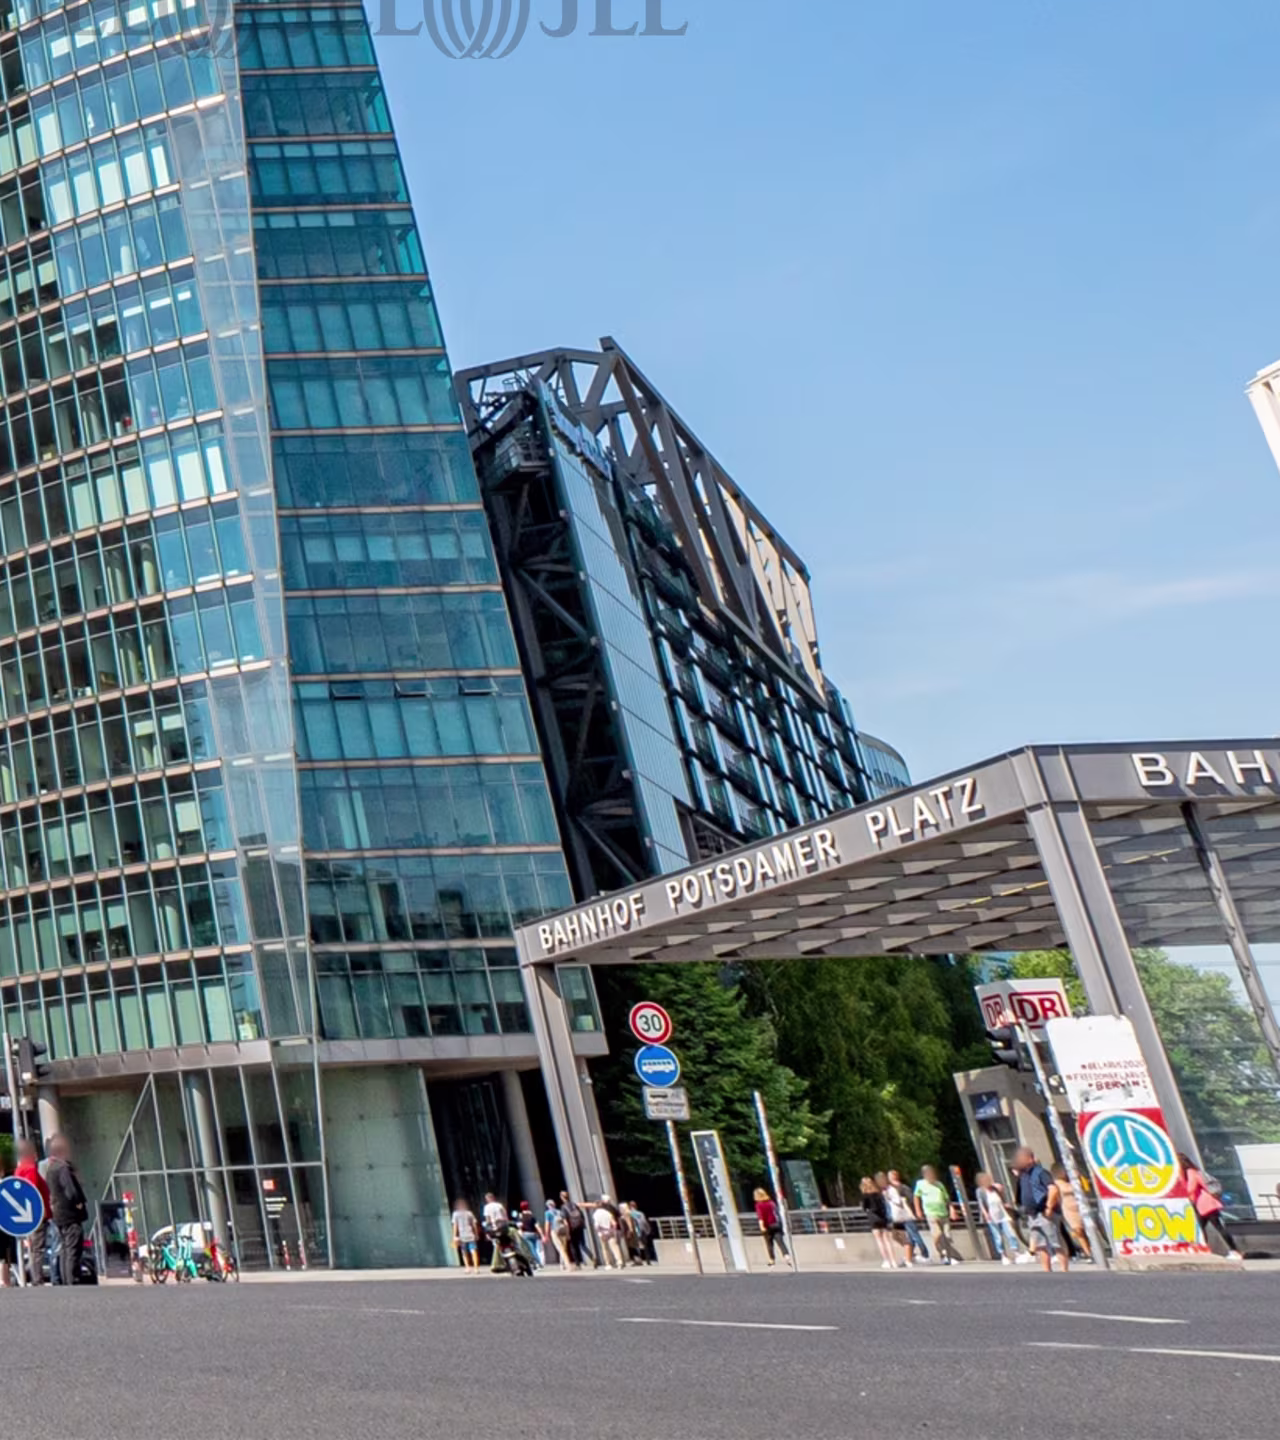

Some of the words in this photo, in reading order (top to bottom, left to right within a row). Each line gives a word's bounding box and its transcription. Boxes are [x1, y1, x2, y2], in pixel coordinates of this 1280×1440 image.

[537, 893, 644, 950] BAHNHOF
[665, 828, 838, 909] POTSDAMER
[865, 778, 984, 844] PLATZ
[639, 1014, 662, 1032] 30
[1016, 997, 1061, 1023] DB
[1110, 1204, 1200, 1241] NOW
